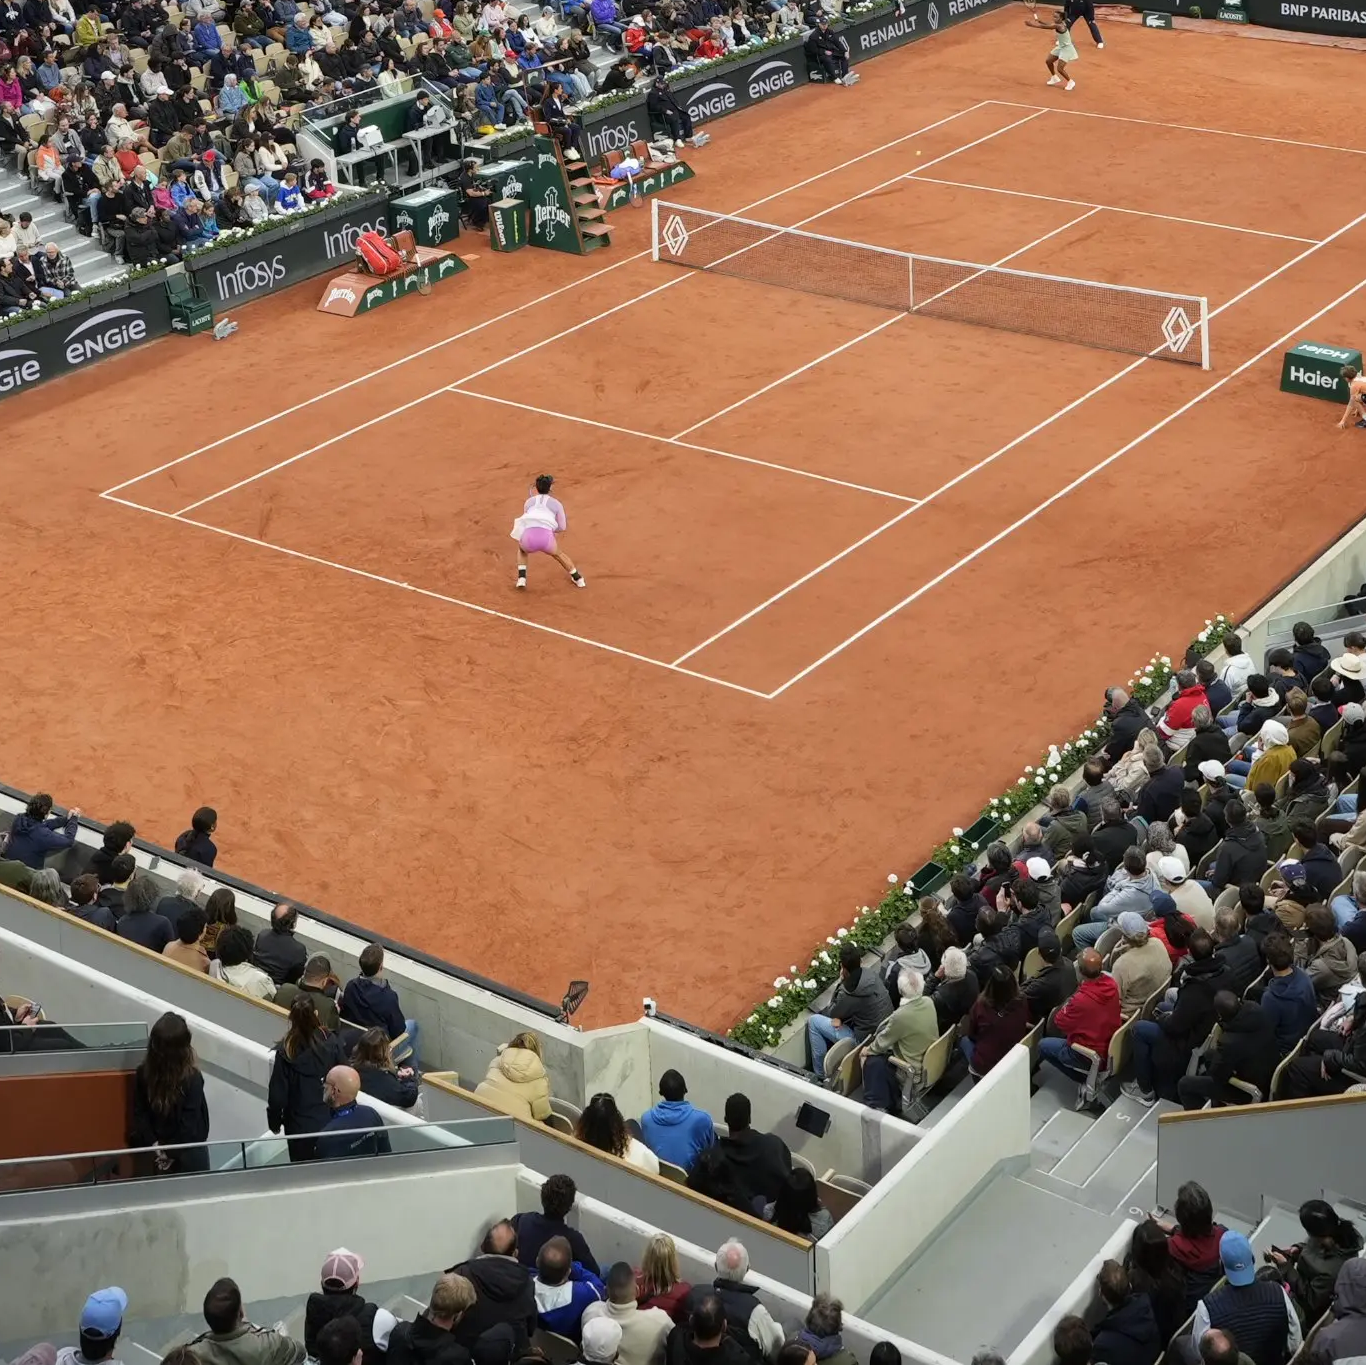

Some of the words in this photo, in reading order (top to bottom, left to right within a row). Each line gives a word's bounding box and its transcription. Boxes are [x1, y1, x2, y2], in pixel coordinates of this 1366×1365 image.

[1219, 11, 1244, 21] LACOSTE
[1281, 2, 1309, 17] BNP
[860, 15, 918, 50] RENAULT
[587, 120, 638, 158] Infosys
[493, 210, 507, 246] Wilson
[535, 204, 571, 234] Perrier
[215, 254, 286, 301] Infosys
[324, 287, 356, 308] Perrier
[191, 314, 212, 327] LACOSTE
[1298, 343, 1350, 360] Haier
[1290, 365, 1339, 390] Haier
